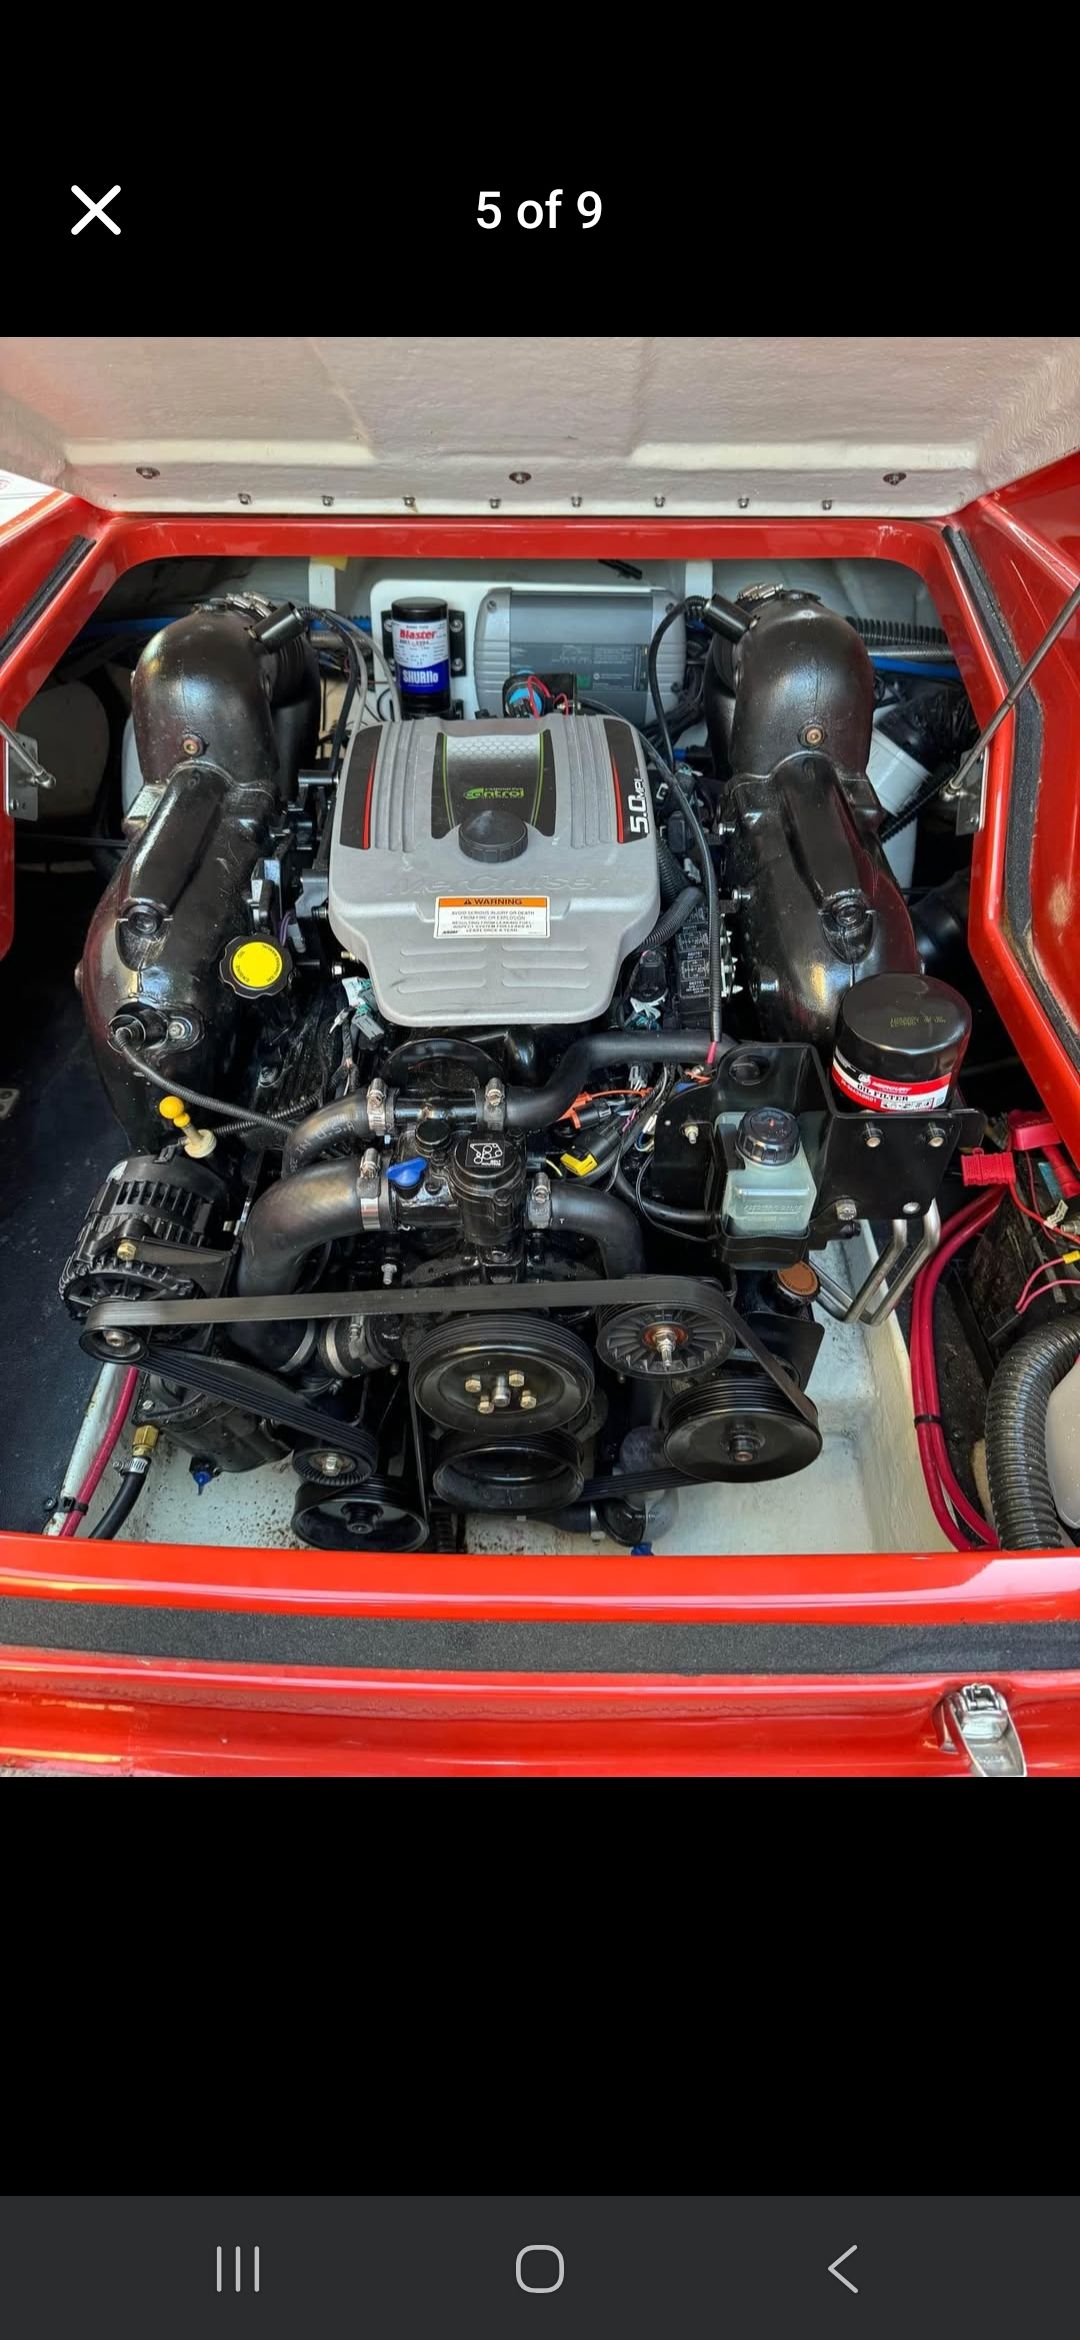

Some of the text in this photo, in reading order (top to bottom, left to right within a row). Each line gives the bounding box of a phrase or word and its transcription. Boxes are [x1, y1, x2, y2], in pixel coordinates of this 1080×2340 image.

[400, 629, 437, 640] Blaster
[628, 795, 649, 833] 5.0
[857, 1084, 909, 1102] OIL FILTER
